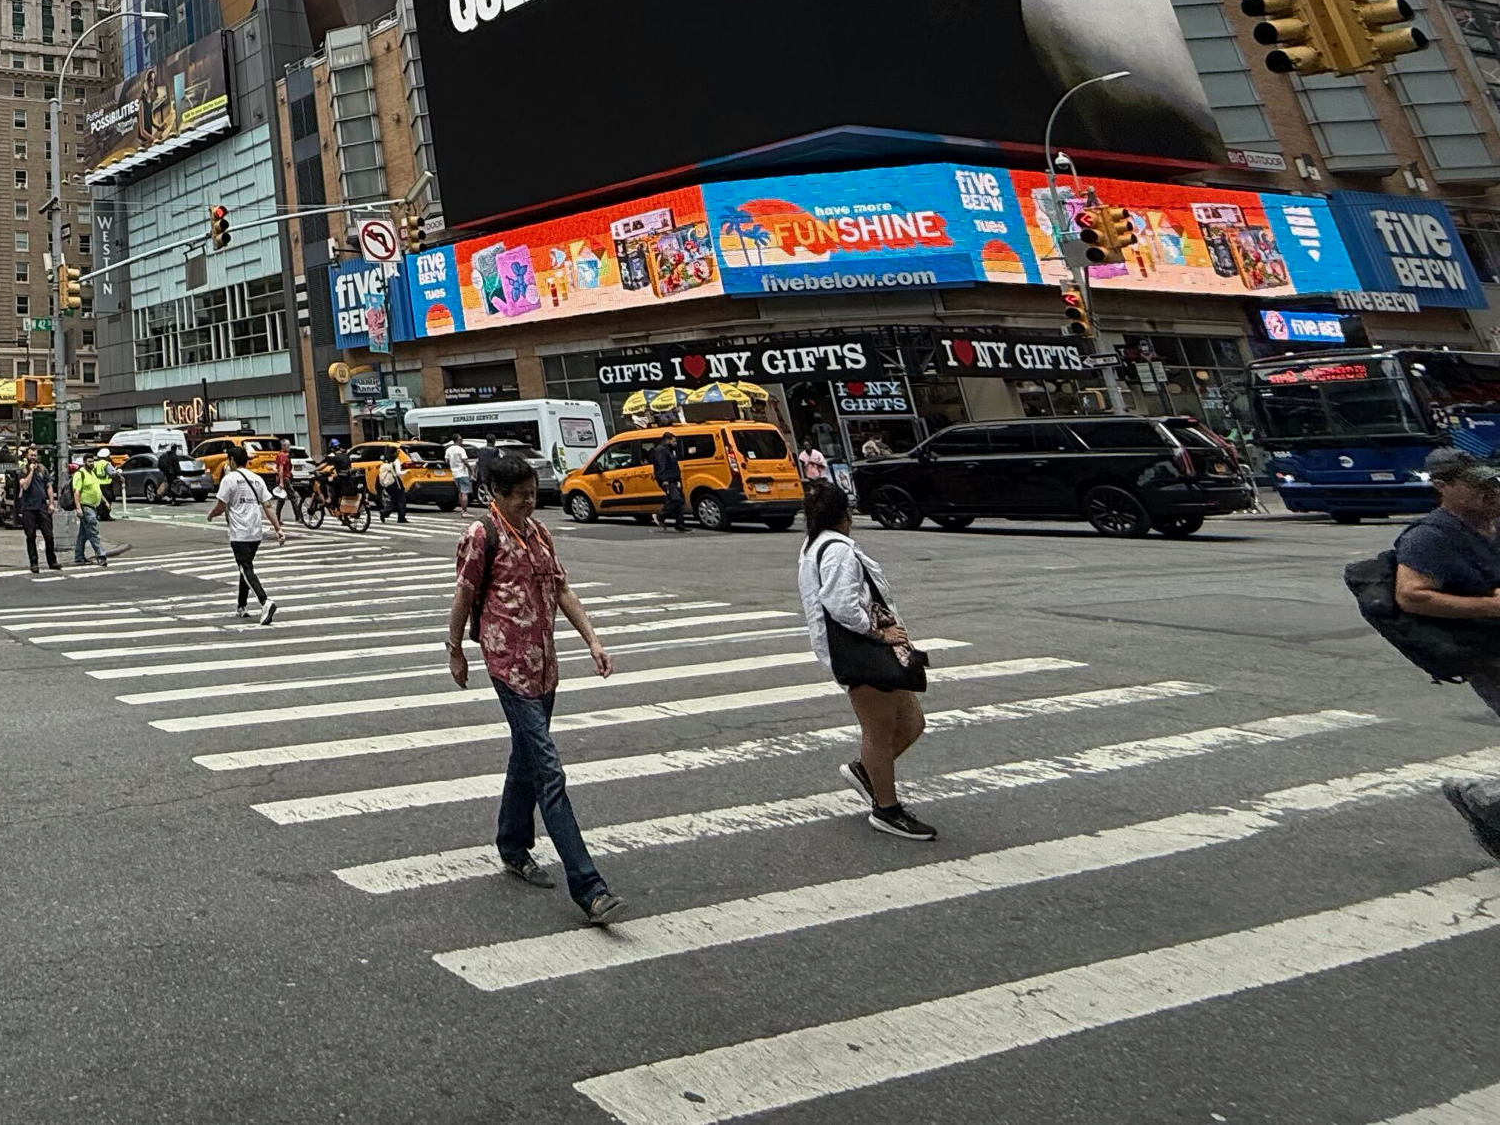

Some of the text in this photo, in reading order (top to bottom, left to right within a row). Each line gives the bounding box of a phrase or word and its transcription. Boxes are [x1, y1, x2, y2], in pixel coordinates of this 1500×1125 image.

[90, 98, 140, 134] POSSIBILITIES
[1227, 152, 1283, 166] BIG OUTDOOR
[955, 170, 1000, 196] five
[814, 202, 892, 216] have more
[773, 210, 941, 248] FUNSHINE
[1370, 209, 1452, 257] five
[97, 216, 113, 295] WESTIN
[416, 252, 446, 274] five
[760, 270, 937, 293] fivebelow.com
[1391, 256, 1468, 291] BELOW
[335, 268, 385, 309] five
[1338, 290, 1374, 310] five
[38, 319, 47, 330] 42
[338, 309, 370, 336] BEL
[1291, 318, 1320, 335] five
[599, 362, 664, 385] GIFTS
[761, 343, 867, 375] GIFTS
[1015, 343, 1083, 371] GIFTS
[841, 397, 908, 412] GIFTS
